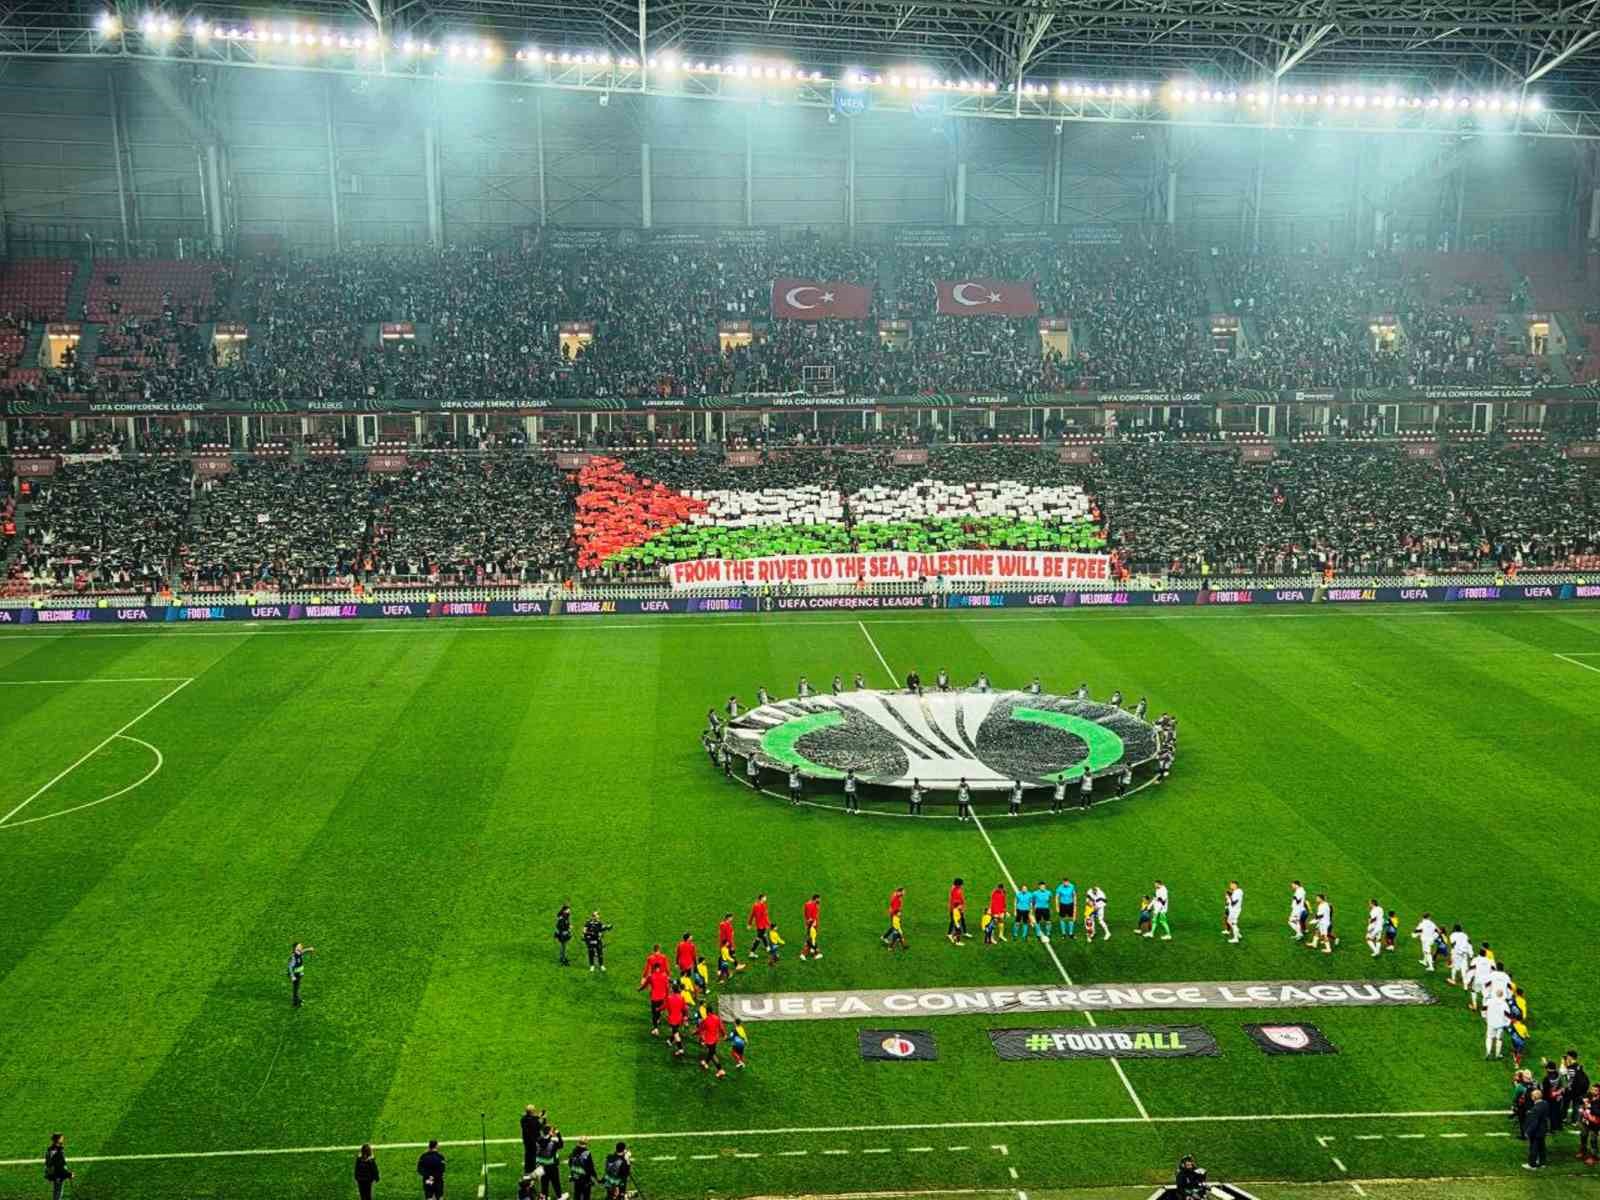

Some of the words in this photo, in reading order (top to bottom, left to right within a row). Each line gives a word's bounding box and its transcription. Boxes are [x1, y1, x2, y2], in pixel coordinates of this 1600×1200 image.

[1448, 391, 1499, 399] CONFERENCE
[1501, 390, 1532, 398] LEAGUE
[90, 403, 112, 411] UEFA
[114, 403, 170, 411] CONFERENCE
[172, 402, 203, 411] LEAGUE
[674, 560, 721, 583] FROM
[723, 560, 754, 581] THE
[758, 559, 808, 581] RIVER
[811, 558, 832, 579] TO
[836, 556, 867, 578] THE
[869, 556, 904, 577] SEA,
[907, 554, 994, 577] PALESTINE
[999, 555, 1039, 577] WILL
[1043, 557, 1064, 578] BE
[1066, 558, 1106, 579] FREE
[1152, 592, 1180, 602] UEFA
[1276, 590, 1304, 600] UEFA
[1329, 590, 1361, 600] WELCOME
[1401, 589, 1428, 599] UEFA
[1524, 587, 1552, 597] UEFA
[779, 599, 808, 608] UEFA
[809, 597, 879, 608] CONFERENCE
[882, 596, 924, 606] LEAGUE
[1028, 594, 1056, 604] UEFA
[1080, 593, 1113, 604] WELCOME
[306, 605, 340, 617] WELCOME
[383, 605, 412, 615] UEFA
[512, 602, 541, 613] UEFA
[566, 602, 600, 613] WELCOME
[641, 600, 669, 611] UEFA
[38, 610, 75, 622] WELCOME
[117, 609, 148, 620] UEFA
[251, 606, 281, 617] UEFA
[742, 997, 872, 1016] UEFA
[883, 986, 1207, 1011] CONFERENCE
[1217, 984, 1405, 1002] LEAGUE
[1025, 1032, 1187, 1051] #FOOTBALL
